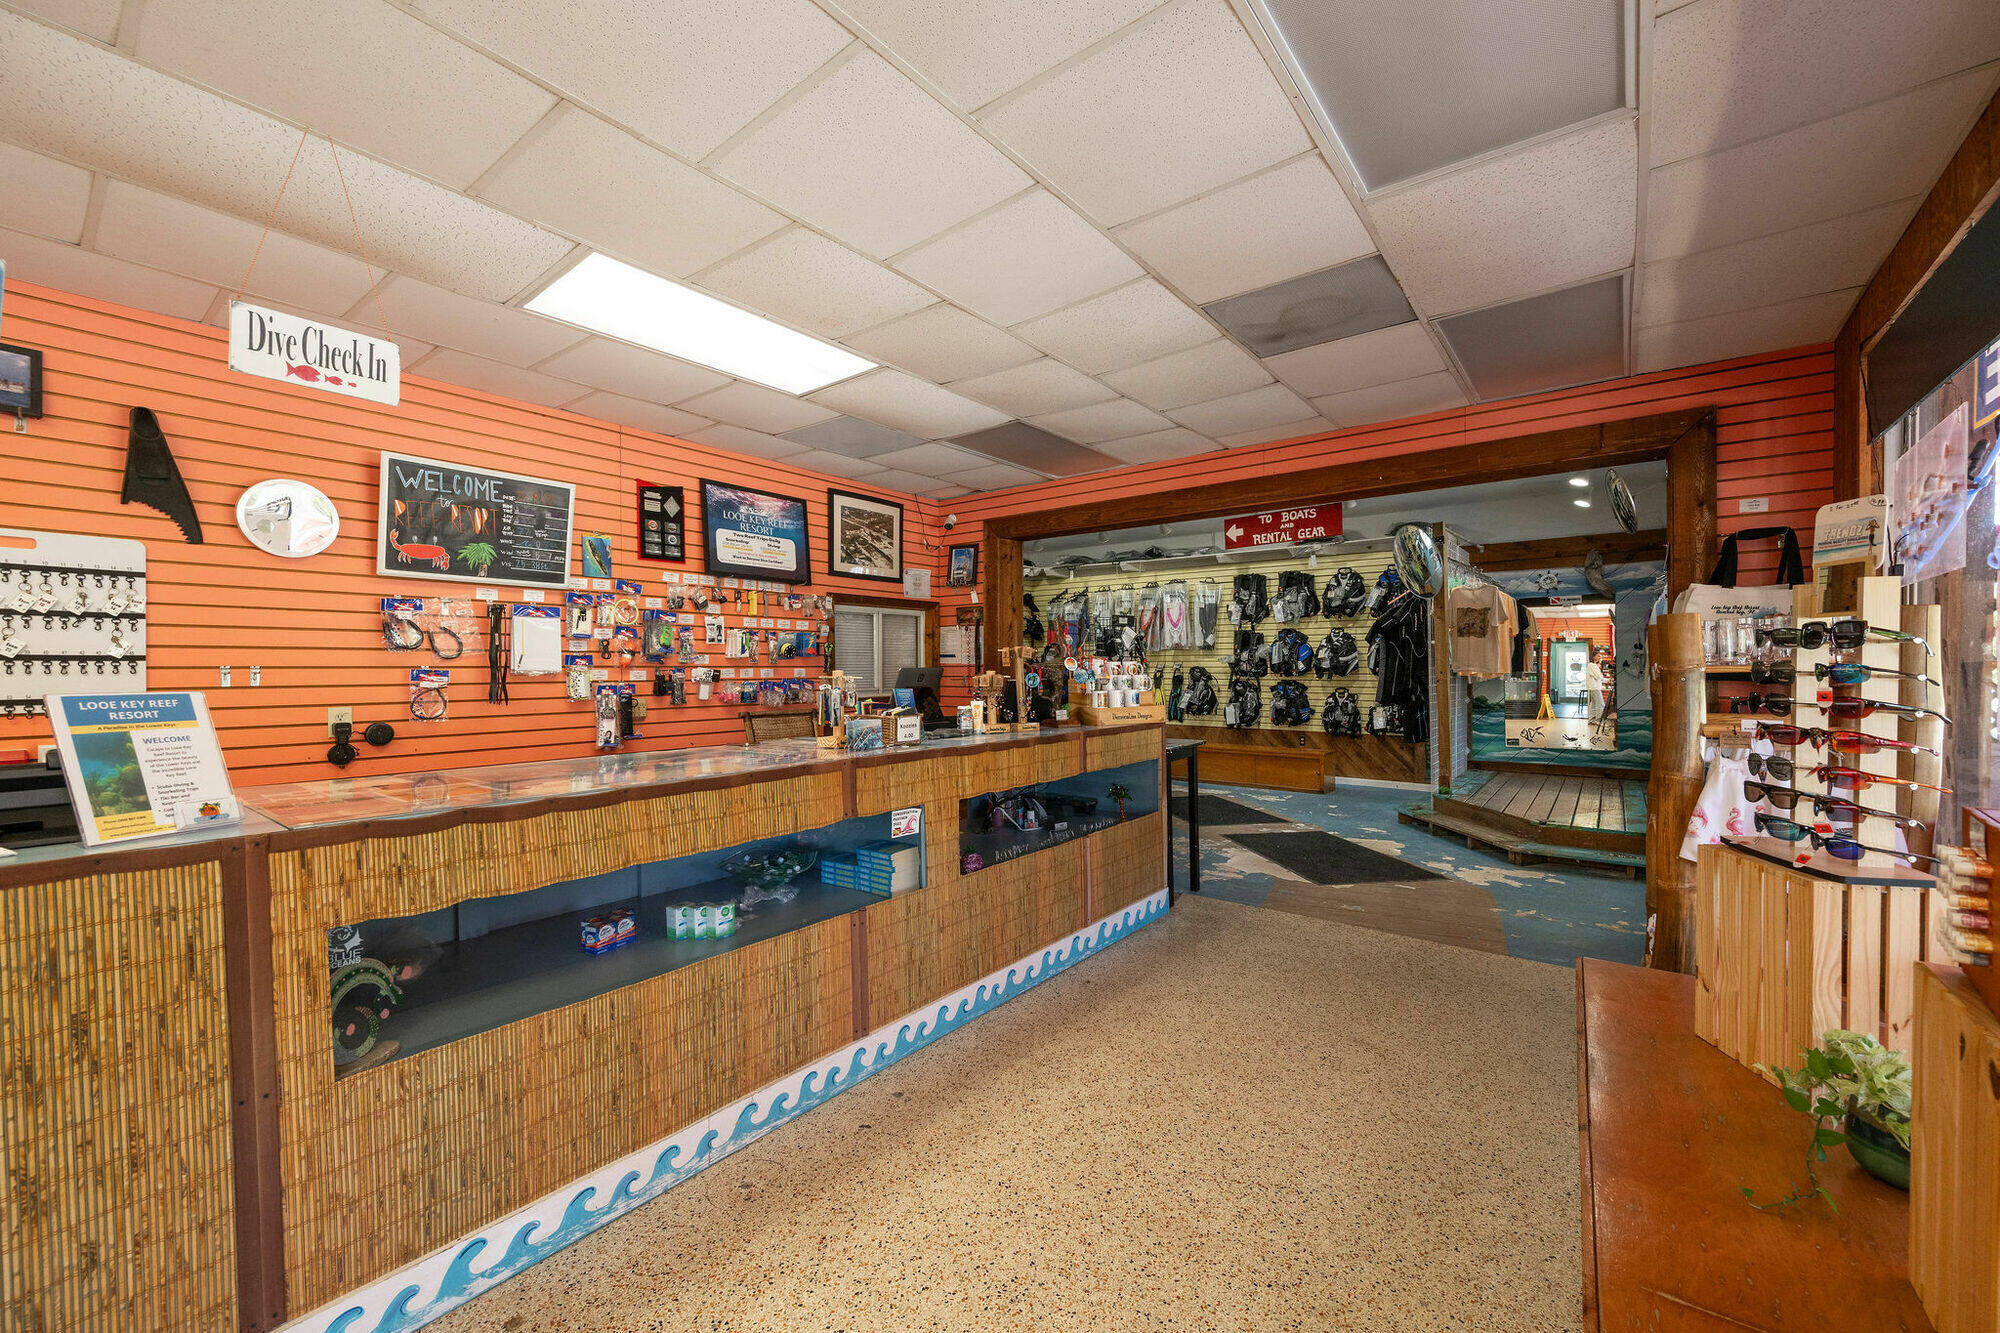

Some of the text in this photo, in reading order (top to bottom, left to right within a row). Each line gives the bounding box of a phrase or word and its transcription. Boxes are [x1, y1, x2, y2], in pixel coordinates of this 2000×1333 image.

[248, 310, 387, 382] Dive Check In
[395, 465, 505, 502] WELCOME
[436, 495, 453, 508] to
[394, 499, 441, 528] REEF
[451, 504, 499, 536] RESORT
[723, 510, 747, 522] LOOE
[1258, 508, 1317, 525] TO BOATS
[740, 522, 774, 536] RESORT
[1280, 522, 1295, 530] AND
[1824, 525, 1863, 540] TRENDZ
[1252, 526, 1326, 545] RENTAL GEAR
[78, 699, 178, 711] LOOE KEY REEF
[109, 710, 160, 720] RESORT
[142, 735, 192, 744] WELCOME
